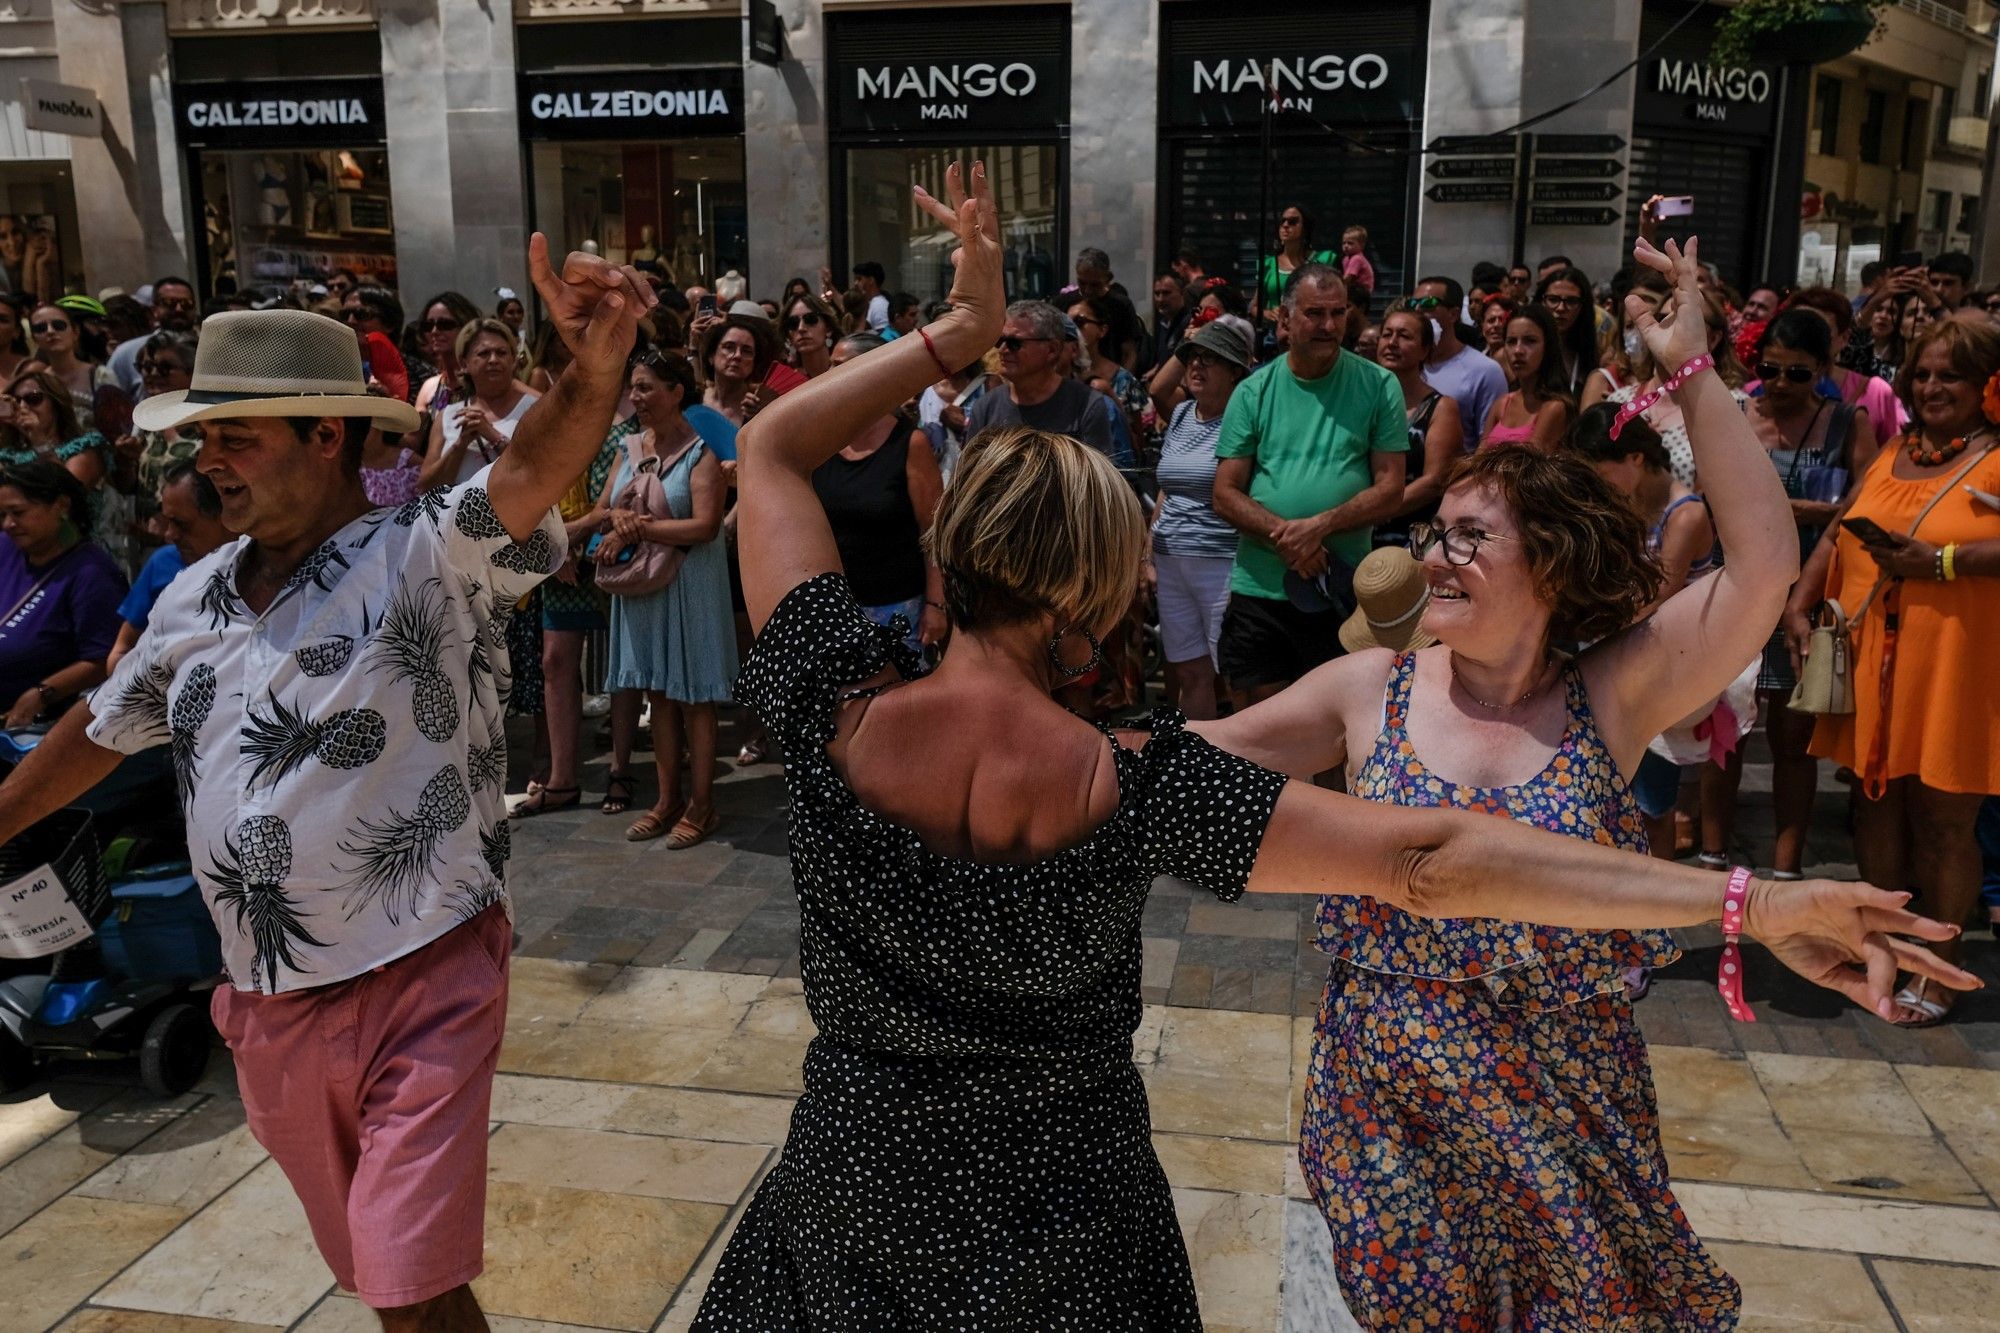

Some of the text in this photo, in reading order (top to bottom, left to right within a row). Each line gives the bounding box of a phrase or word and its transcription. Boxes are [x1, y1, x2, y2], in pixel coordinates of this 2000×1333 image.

[857, 62, 1036, 99] MANGO
[1193, 53, 1388, 94] MANGO
[1658, 57, 1770, 104] MANGO
[187, 99, 368, 127] CALZEDONIA
[531, 89, 729, 119] CALZEDONIA
[920, 104, 968, 119] MAN
[1696, 103, 1727, 121] MAN
[31, 879, 48, 893] 40
[13, 916, 67, 938] CORTESÍA
